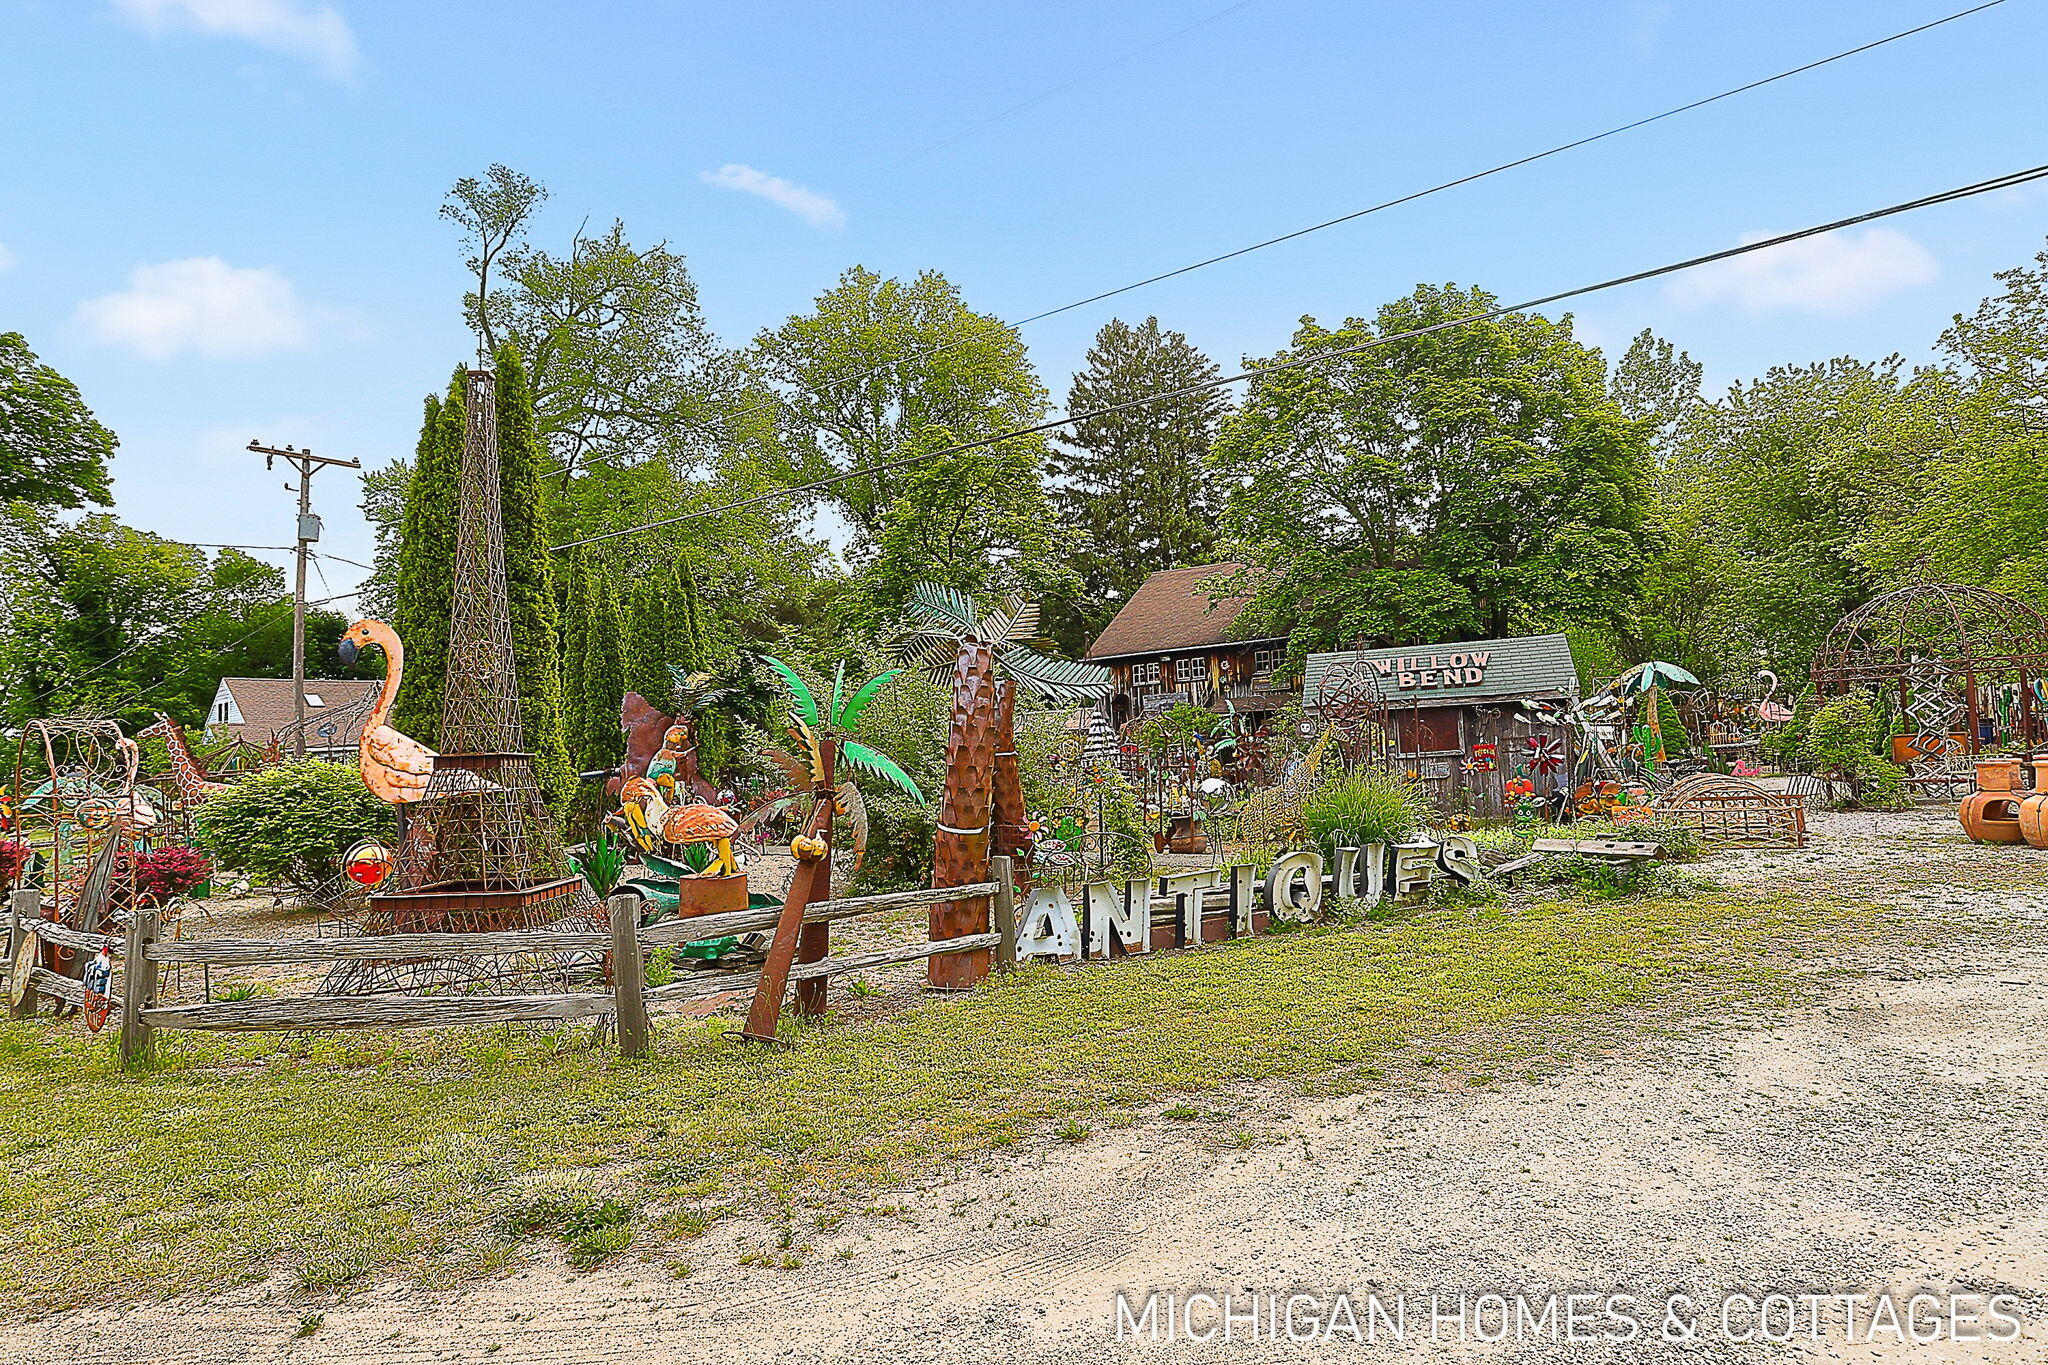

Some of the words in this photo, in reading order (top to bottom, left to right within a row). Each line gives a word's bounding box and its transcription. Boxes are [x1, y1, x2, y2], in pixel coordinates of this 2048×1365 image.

[1371, 651, 1491, 677] WILLOW
[1398, 667, 1484, 690] BEND
[1015, 836, 1481, 964] ANTIQUES
